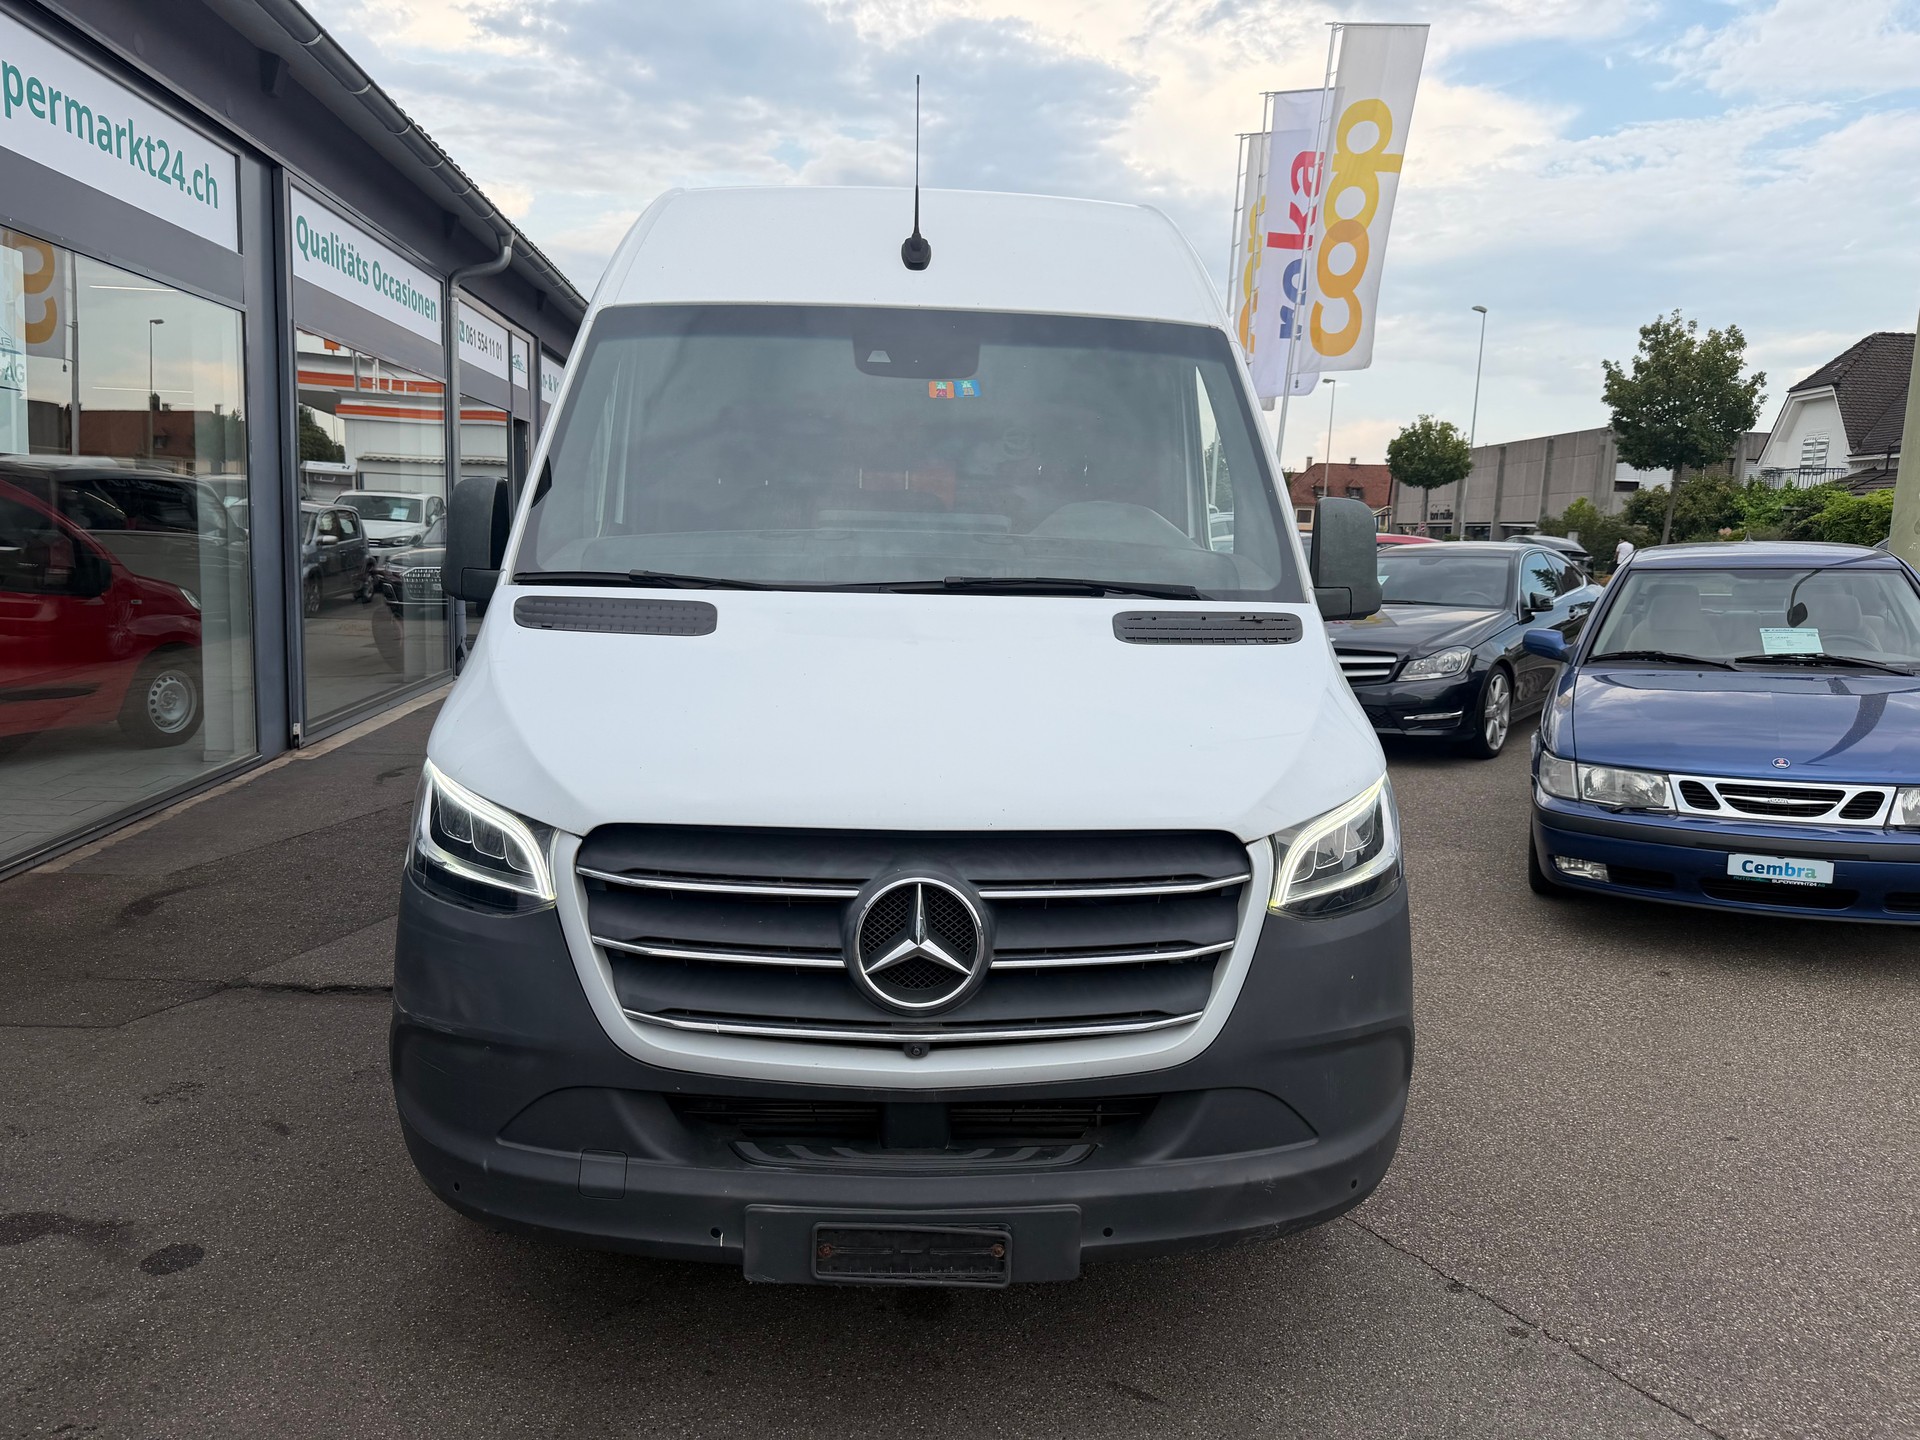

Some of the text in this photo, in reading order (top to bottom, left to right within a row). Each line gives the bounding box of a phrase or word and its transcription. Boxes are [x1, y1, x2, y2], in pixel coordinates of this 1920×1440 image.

[2, 60, 218, 209] permarkt24.ch
[296, 215, 437, 323] Qualitäts Occasionen
[1309, 98, 1403, 357] coop
[465, 325, 502, 361] 061 554 11 01
[1741, 860, 1817, 879] Cembra
